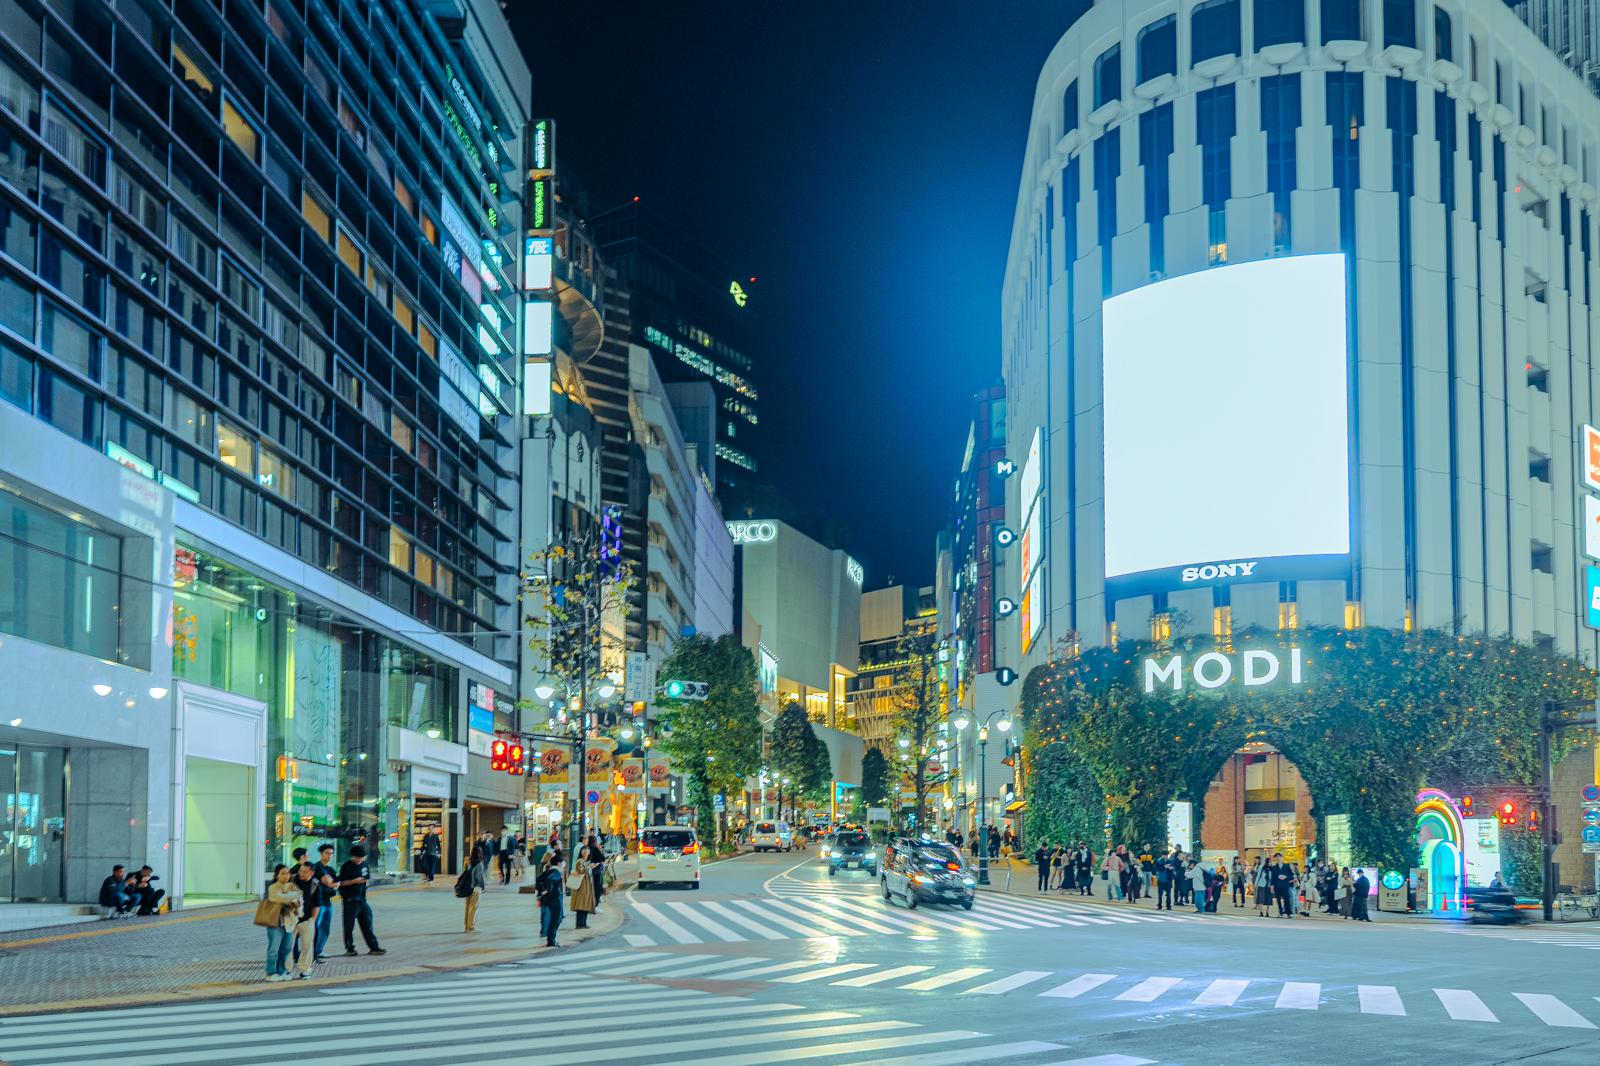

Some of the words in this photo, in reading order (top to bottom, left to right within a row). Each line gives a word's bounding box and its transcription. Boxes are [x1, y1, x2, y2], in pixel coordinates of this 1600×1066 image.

[726, 521, 777, 543] ARCO
[1181, 561, 1258, 582] SONY
[1144, 648, 1302, 693] MODI
